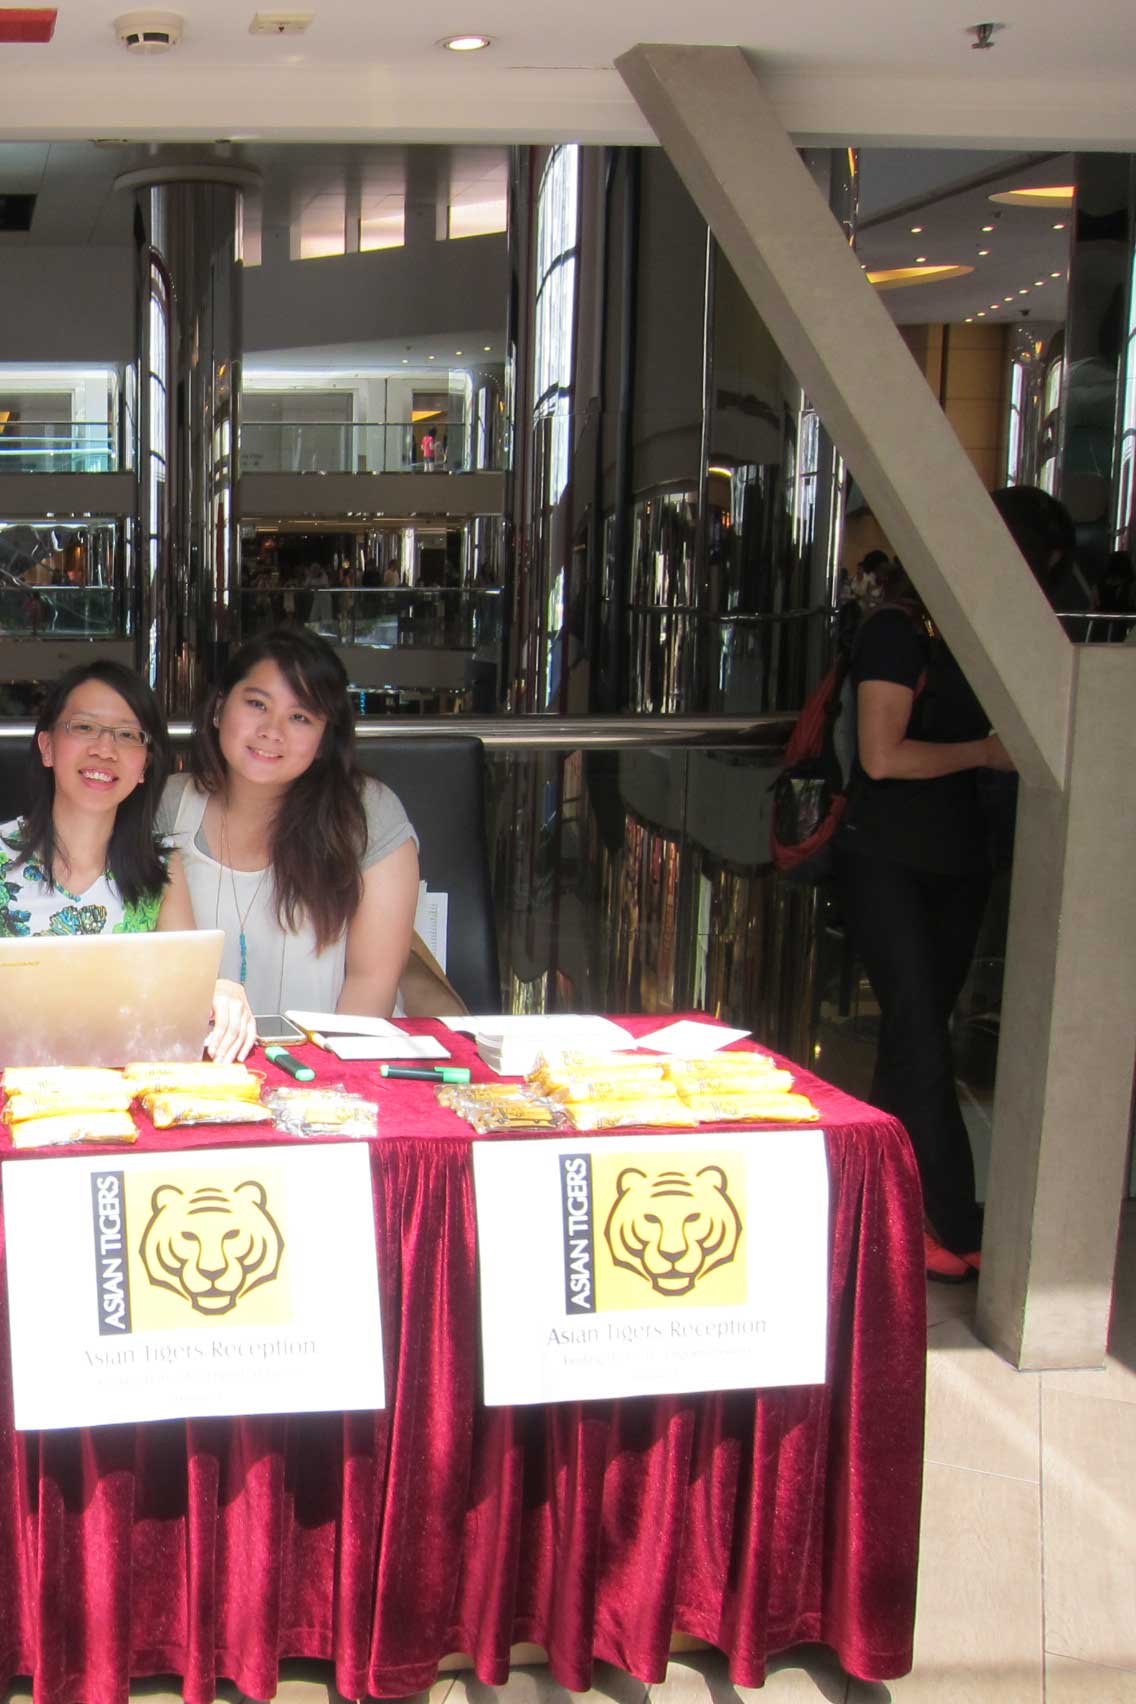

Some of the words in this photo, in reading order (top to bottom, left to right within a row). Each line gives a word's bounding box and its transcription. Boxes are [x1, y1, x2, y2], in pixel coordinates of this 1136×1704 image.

[96, 1174, 121, 1255] TIGERS
[565, 1157, 589, 1236] TIGERS
[102, 1258, 126, 1330] ASIAN
[569, 1239, 592, 1310] ASIAN
[81, 1347, 135, 1368] Asian
[144, 1343, 206, 1366] Tigers
[211, 1335, 318, 1360] Reception
[546, 1326, 599, 1347] Asian
[607, 1321, 664, 1344] Tigers
[670, 1317, 768, 1341] Reception
